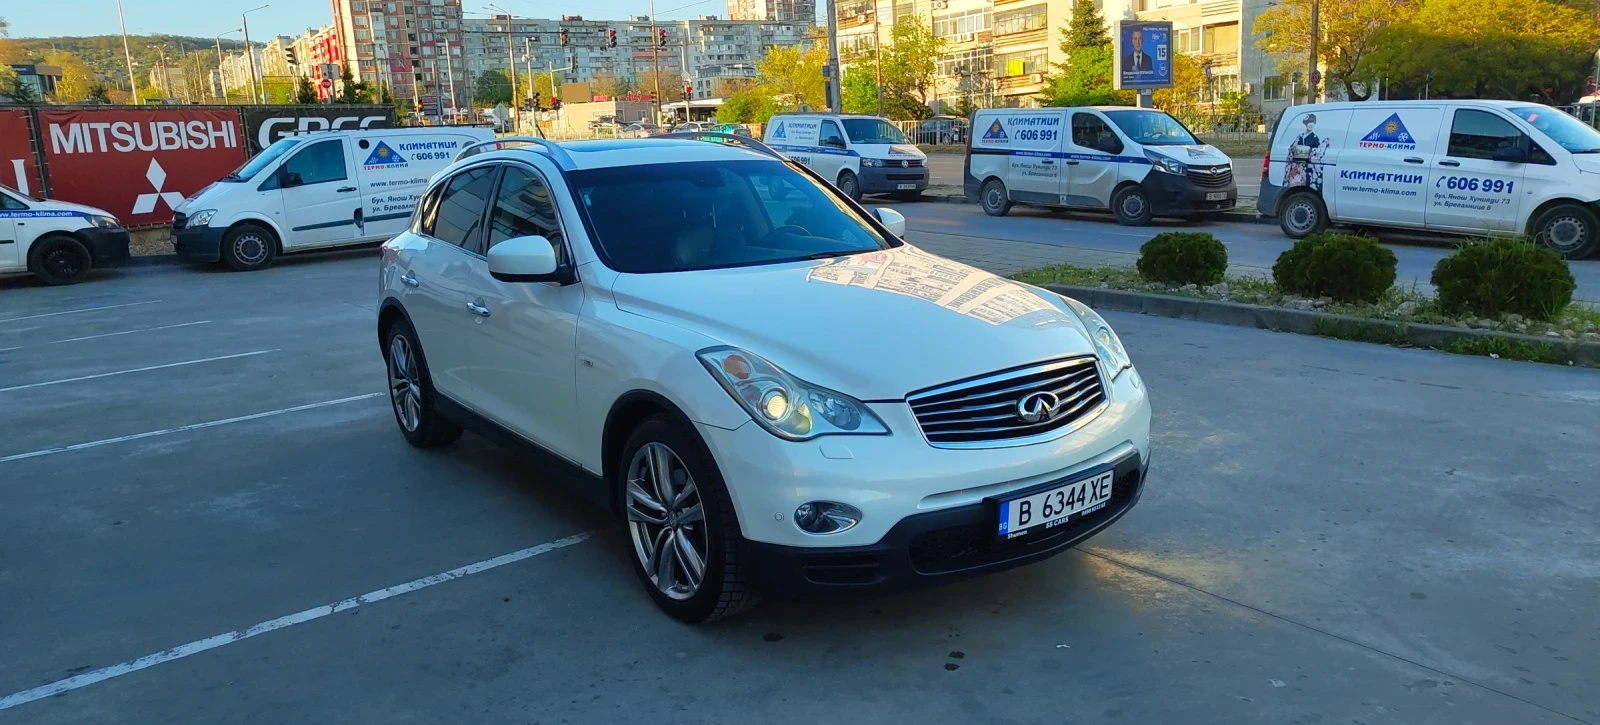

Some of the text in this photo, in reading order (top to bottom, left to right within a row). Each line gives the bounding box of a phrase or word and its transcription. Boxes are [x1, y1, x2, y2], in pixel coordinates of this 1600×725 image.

[1158, 48, 1166, 57] 15
[1007, 117, 1060, 126] КЛИМАТИЦИ
[49, 121, 237, 154] MITSUBISHI
[1020, 130, 1058, 141] 606 991
[399, 141, 458, 151] КЛИМАТИЦИ
[1359, 142, 1416, 151] ТЕРМО-КЛИМА
[417, 152, 450, 160] 606 991
[1340, 170, 1423, 185] КЛИМАТИЦИ
[370, 178, 430, 188] www.termo-klima.
[1447, 176, 1515, 194] 606 991
[1342, 185, 1417, 197] www.termo-klima.com
[1448, 193, 1468, 201] Янош
[1019, 500, 1032, 526] B
[1042, 483, 1087, 519] 6344
[1089, 474, 1111, 504] XE
[998, 521, 1008, 531] BG
[1054, 516, 1069, 526] CARS
[1007, 530, 1028, 540] Shumen
